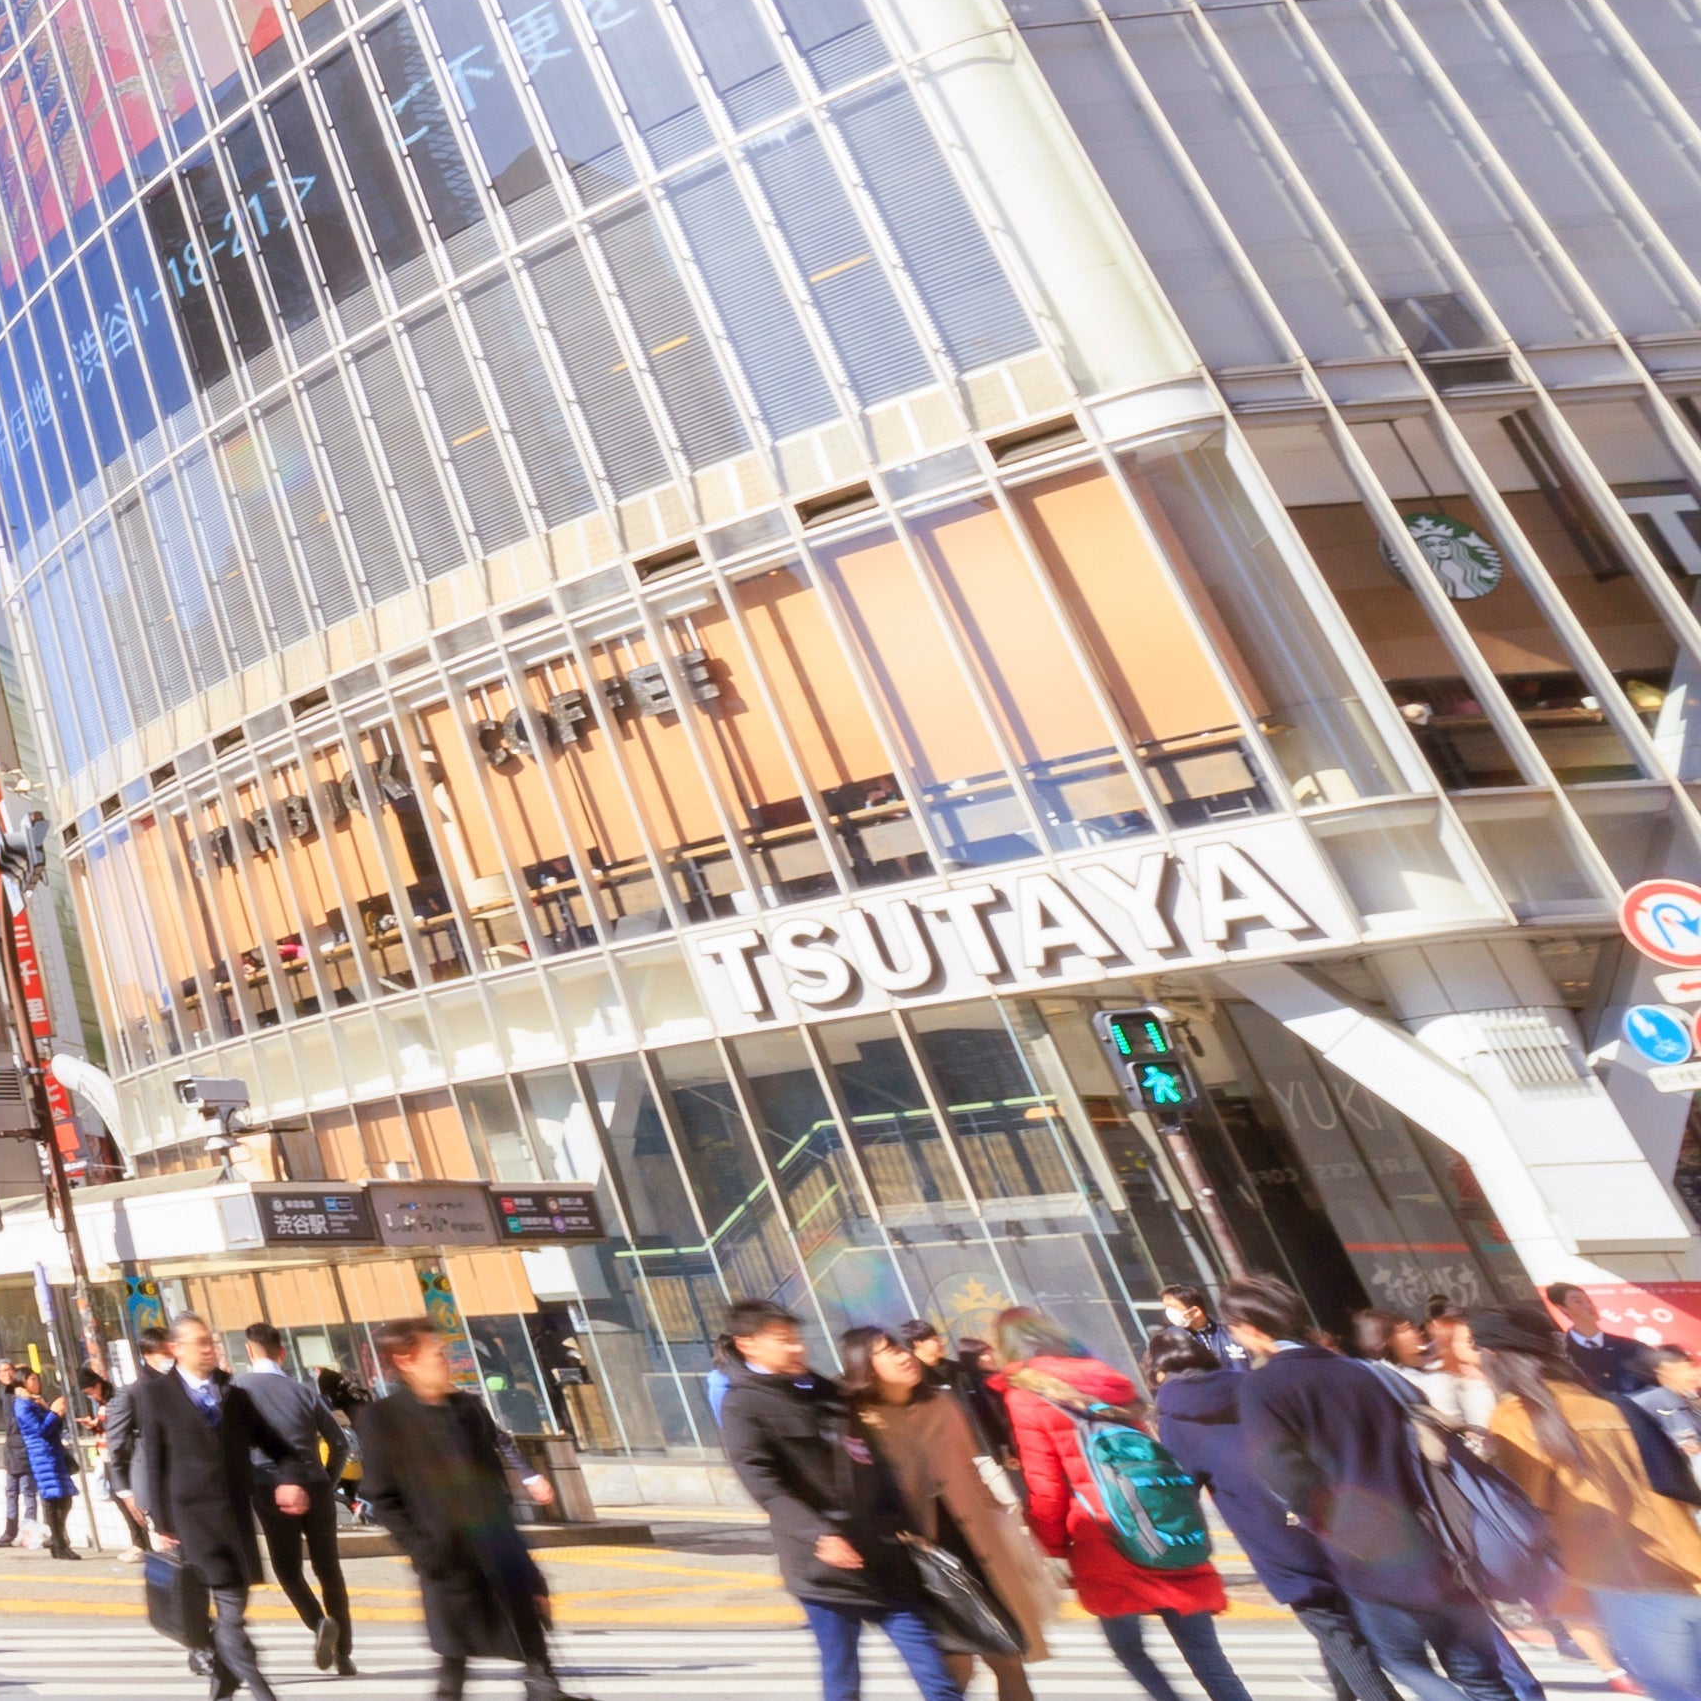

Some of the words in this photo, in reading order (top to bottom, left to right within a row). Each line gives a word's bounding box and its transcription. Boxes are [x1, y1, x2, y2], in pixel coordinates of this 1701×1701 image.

[697, 841, 1311, 1016] TSUTAYA
[273, 1214, 329, 1235] 渋谷駅
[1600, 1307, 1675, 1324] EXO
